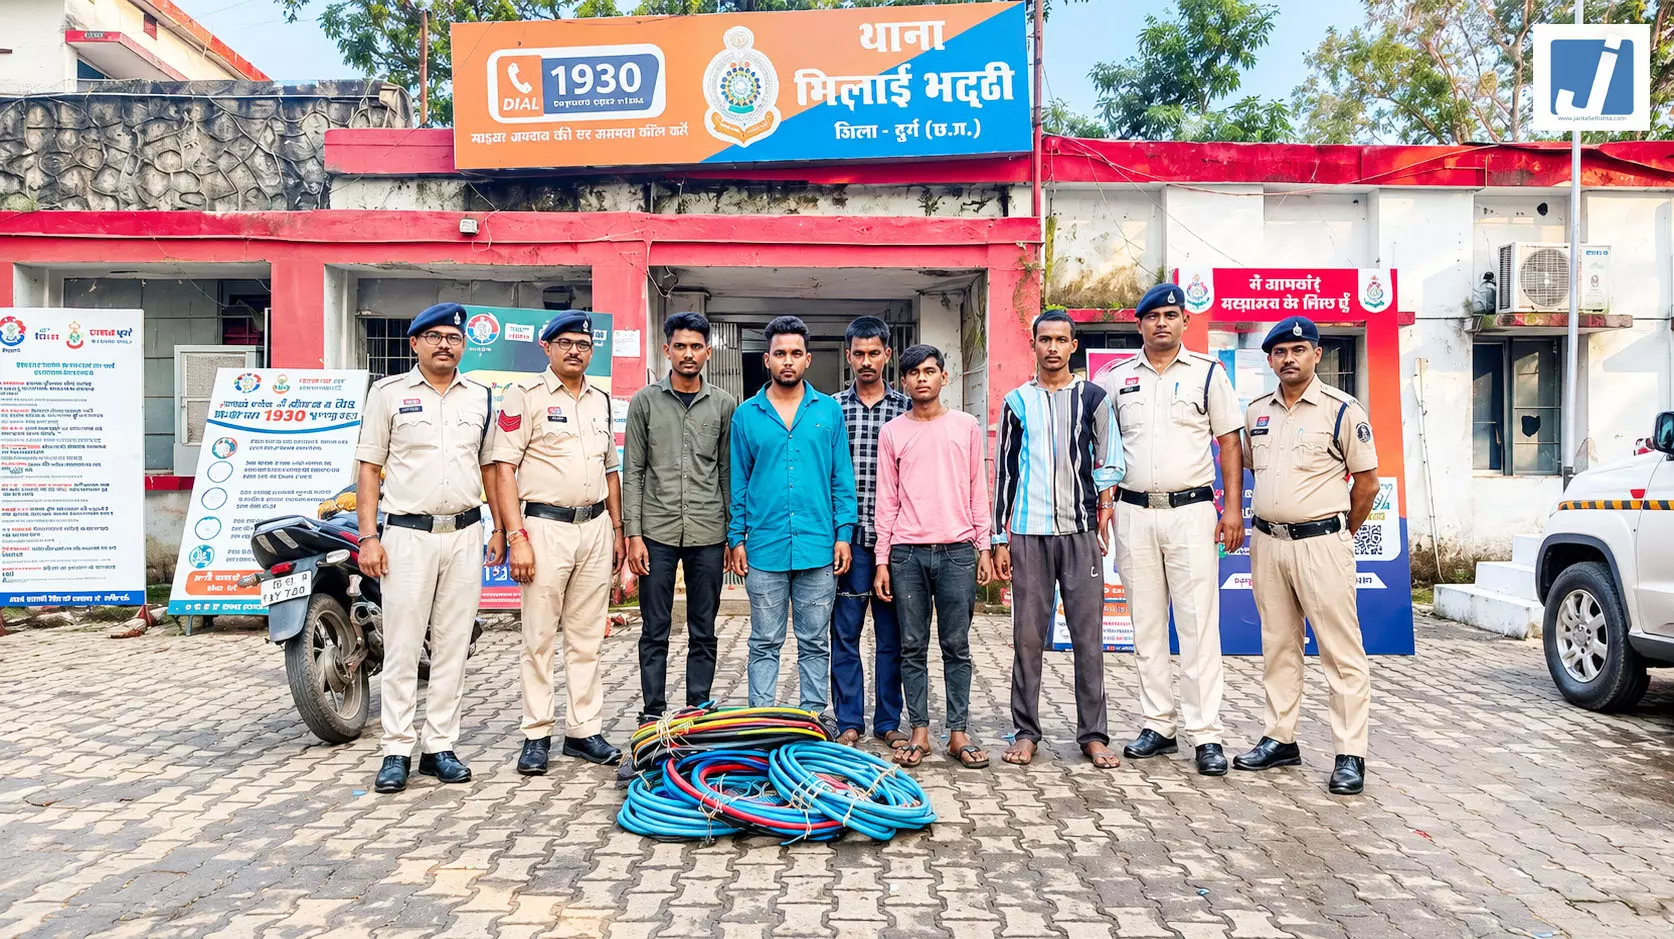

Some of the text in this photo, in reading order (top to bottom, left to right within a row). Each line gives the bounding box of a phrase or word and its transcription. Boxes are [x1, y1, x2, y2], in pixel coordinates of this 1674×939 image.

[859, 20, 946, 53] थाना
[550, 61, 642, 96] 1930
[503, 97, 540, 111] DIAL
[264, 409, 306, 422] 1930
